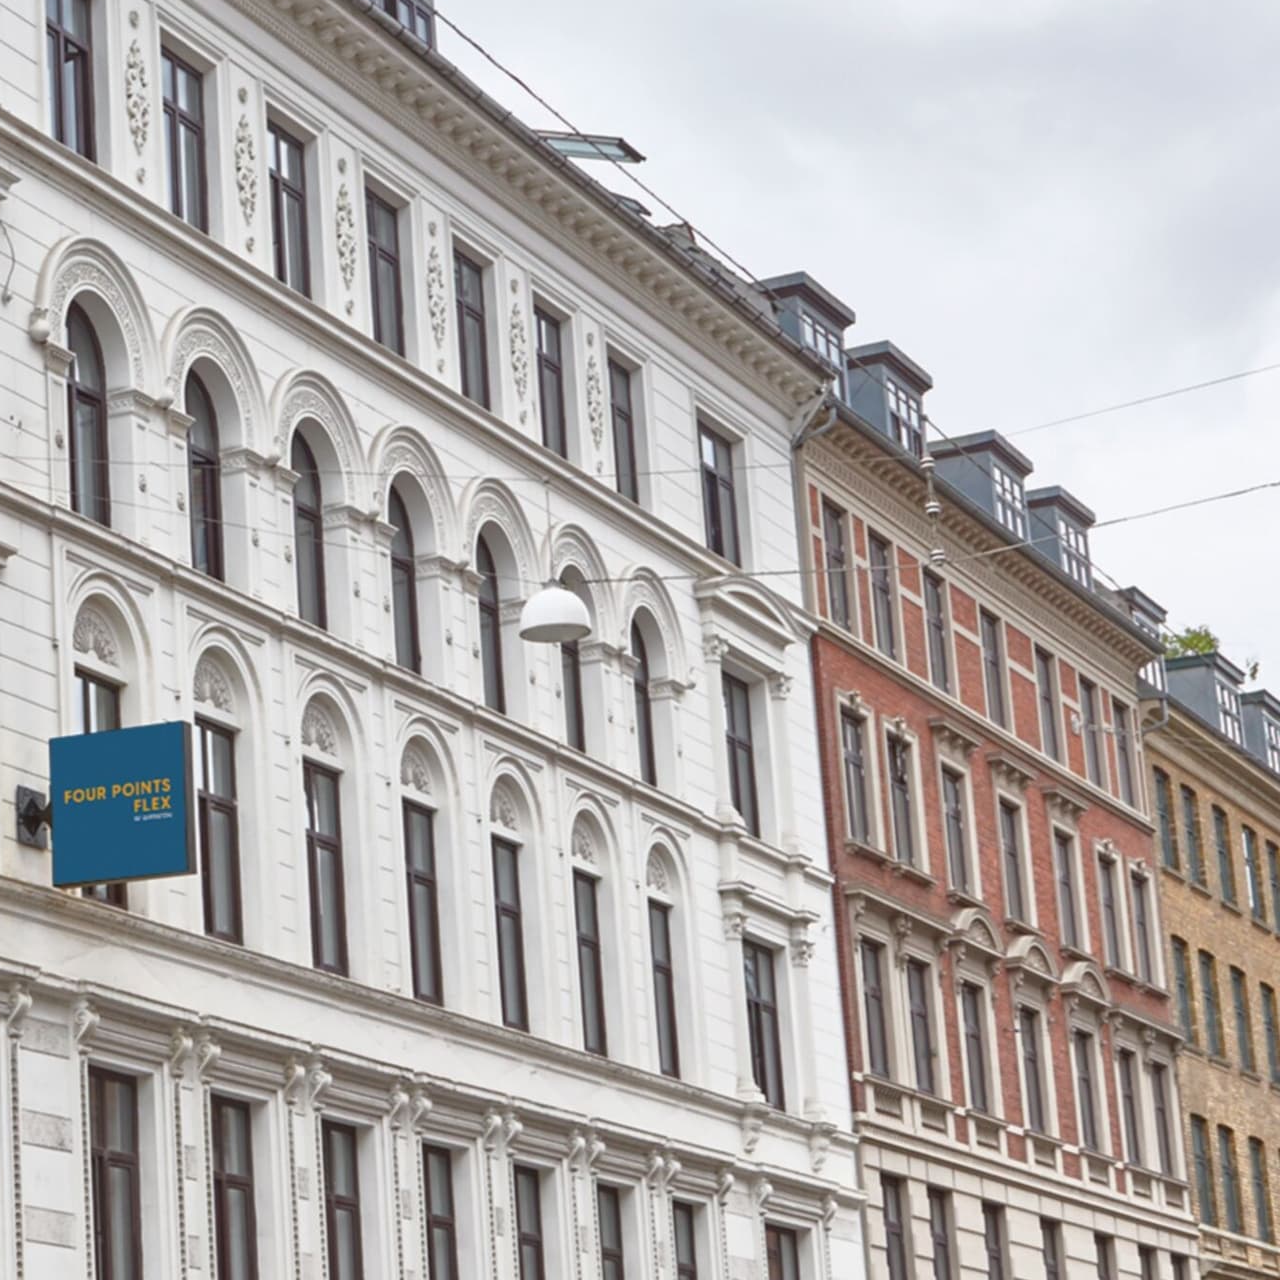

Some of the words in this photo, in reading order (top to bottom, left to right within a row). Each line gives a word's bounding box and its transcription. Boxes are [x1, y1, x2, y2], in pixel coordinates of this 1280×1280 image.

[64, 786, 107, 805] FOUR
[111, 778, 172, 798] POINTS
[133, 796, 172, 813] FLEX
